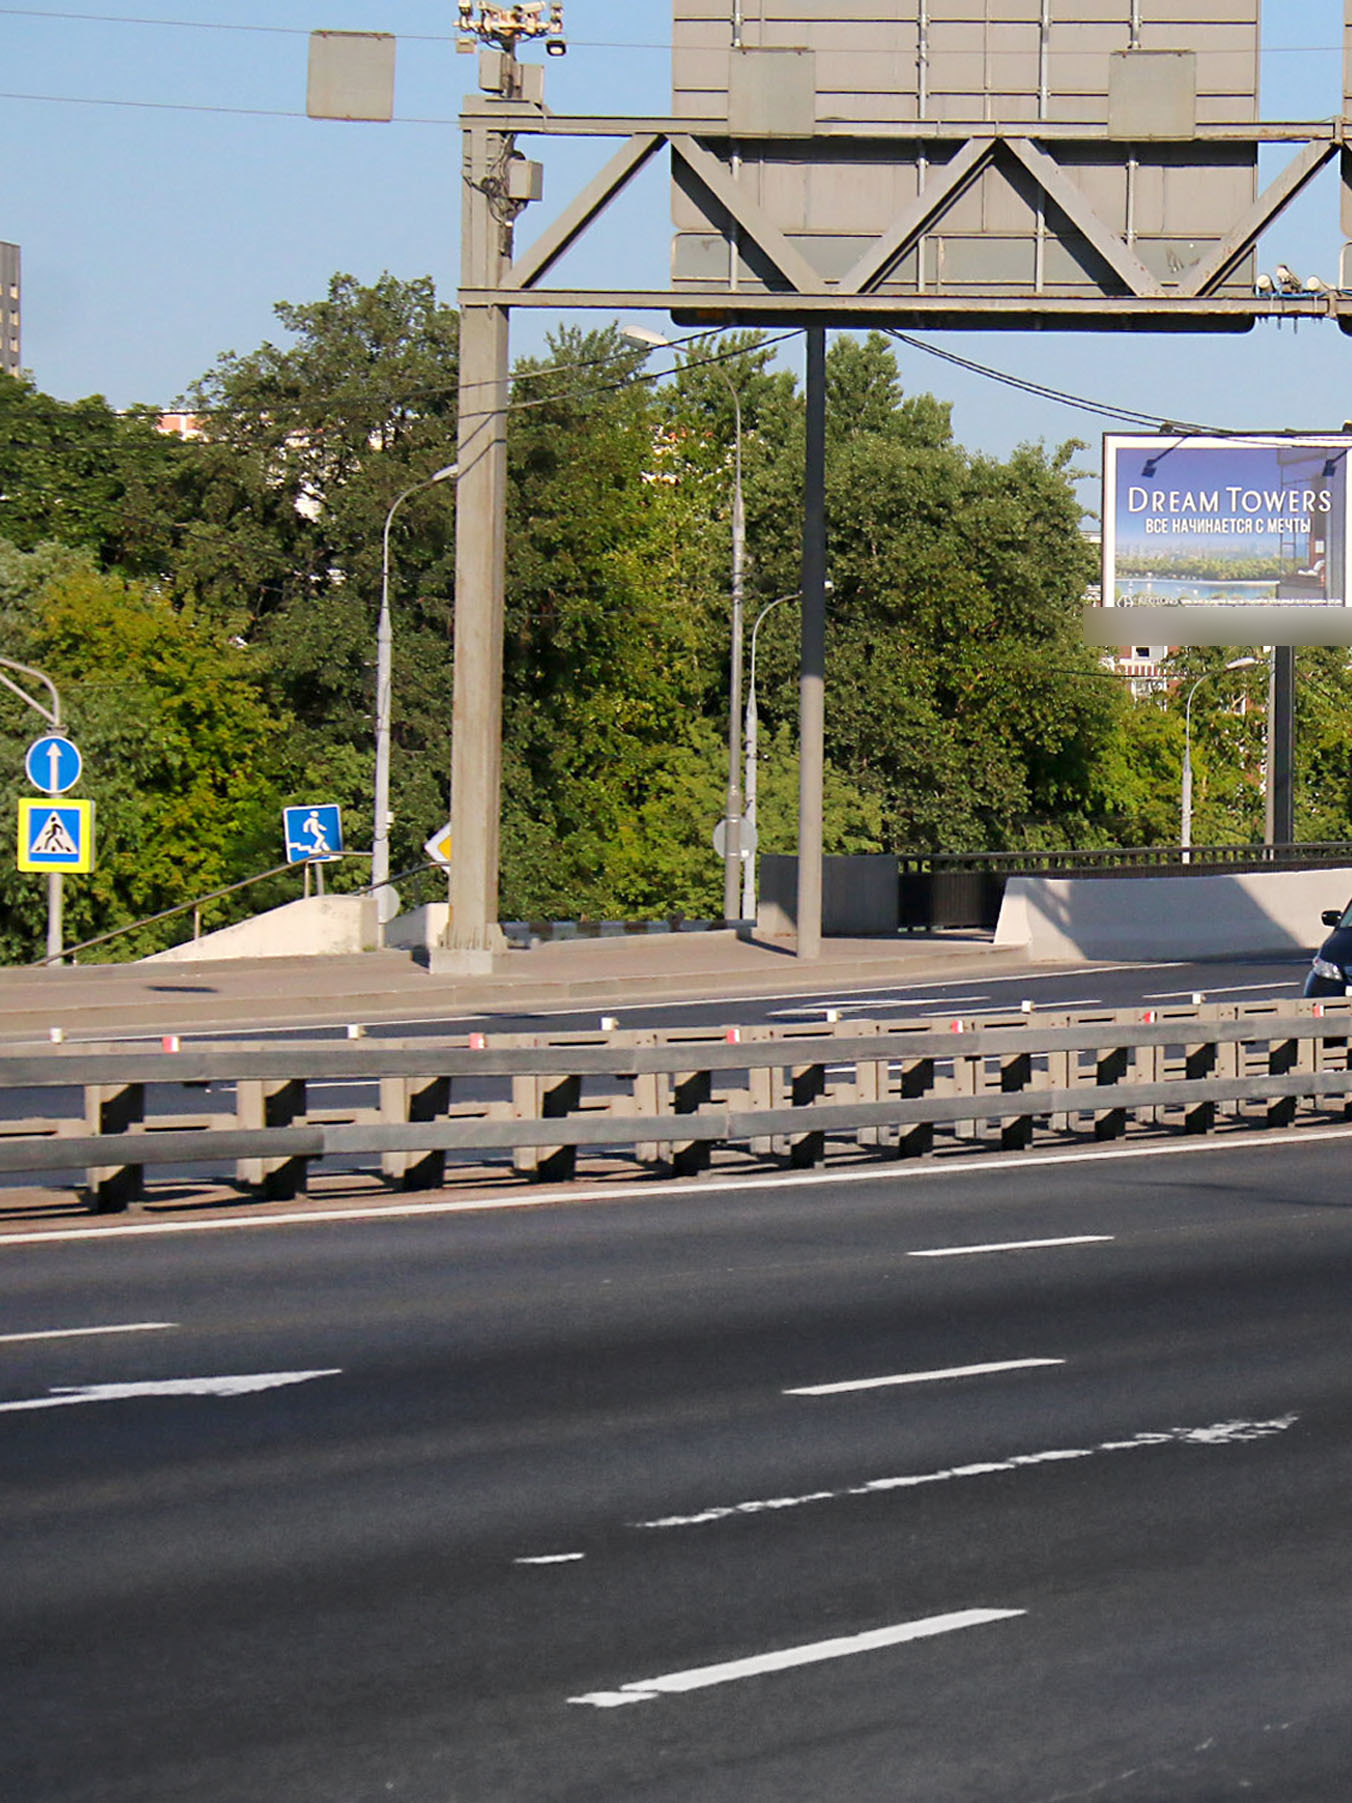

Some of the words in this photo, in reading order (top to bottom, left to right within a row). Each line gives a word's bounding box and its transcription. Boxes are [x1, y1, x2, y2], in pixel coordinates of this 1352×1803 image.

[1128, 486, 1219, 513] DREAM
[1225, 486, 1332, 513] TOWERS
[1145, 518, 1168, 533] ВСЕ
[1172, 518, 1252, 533] НАЧИНАЕТСЯ
[1255, 518, 1264, 533] С
[1267, 518, 1311, 533] МЕЧТЫ
